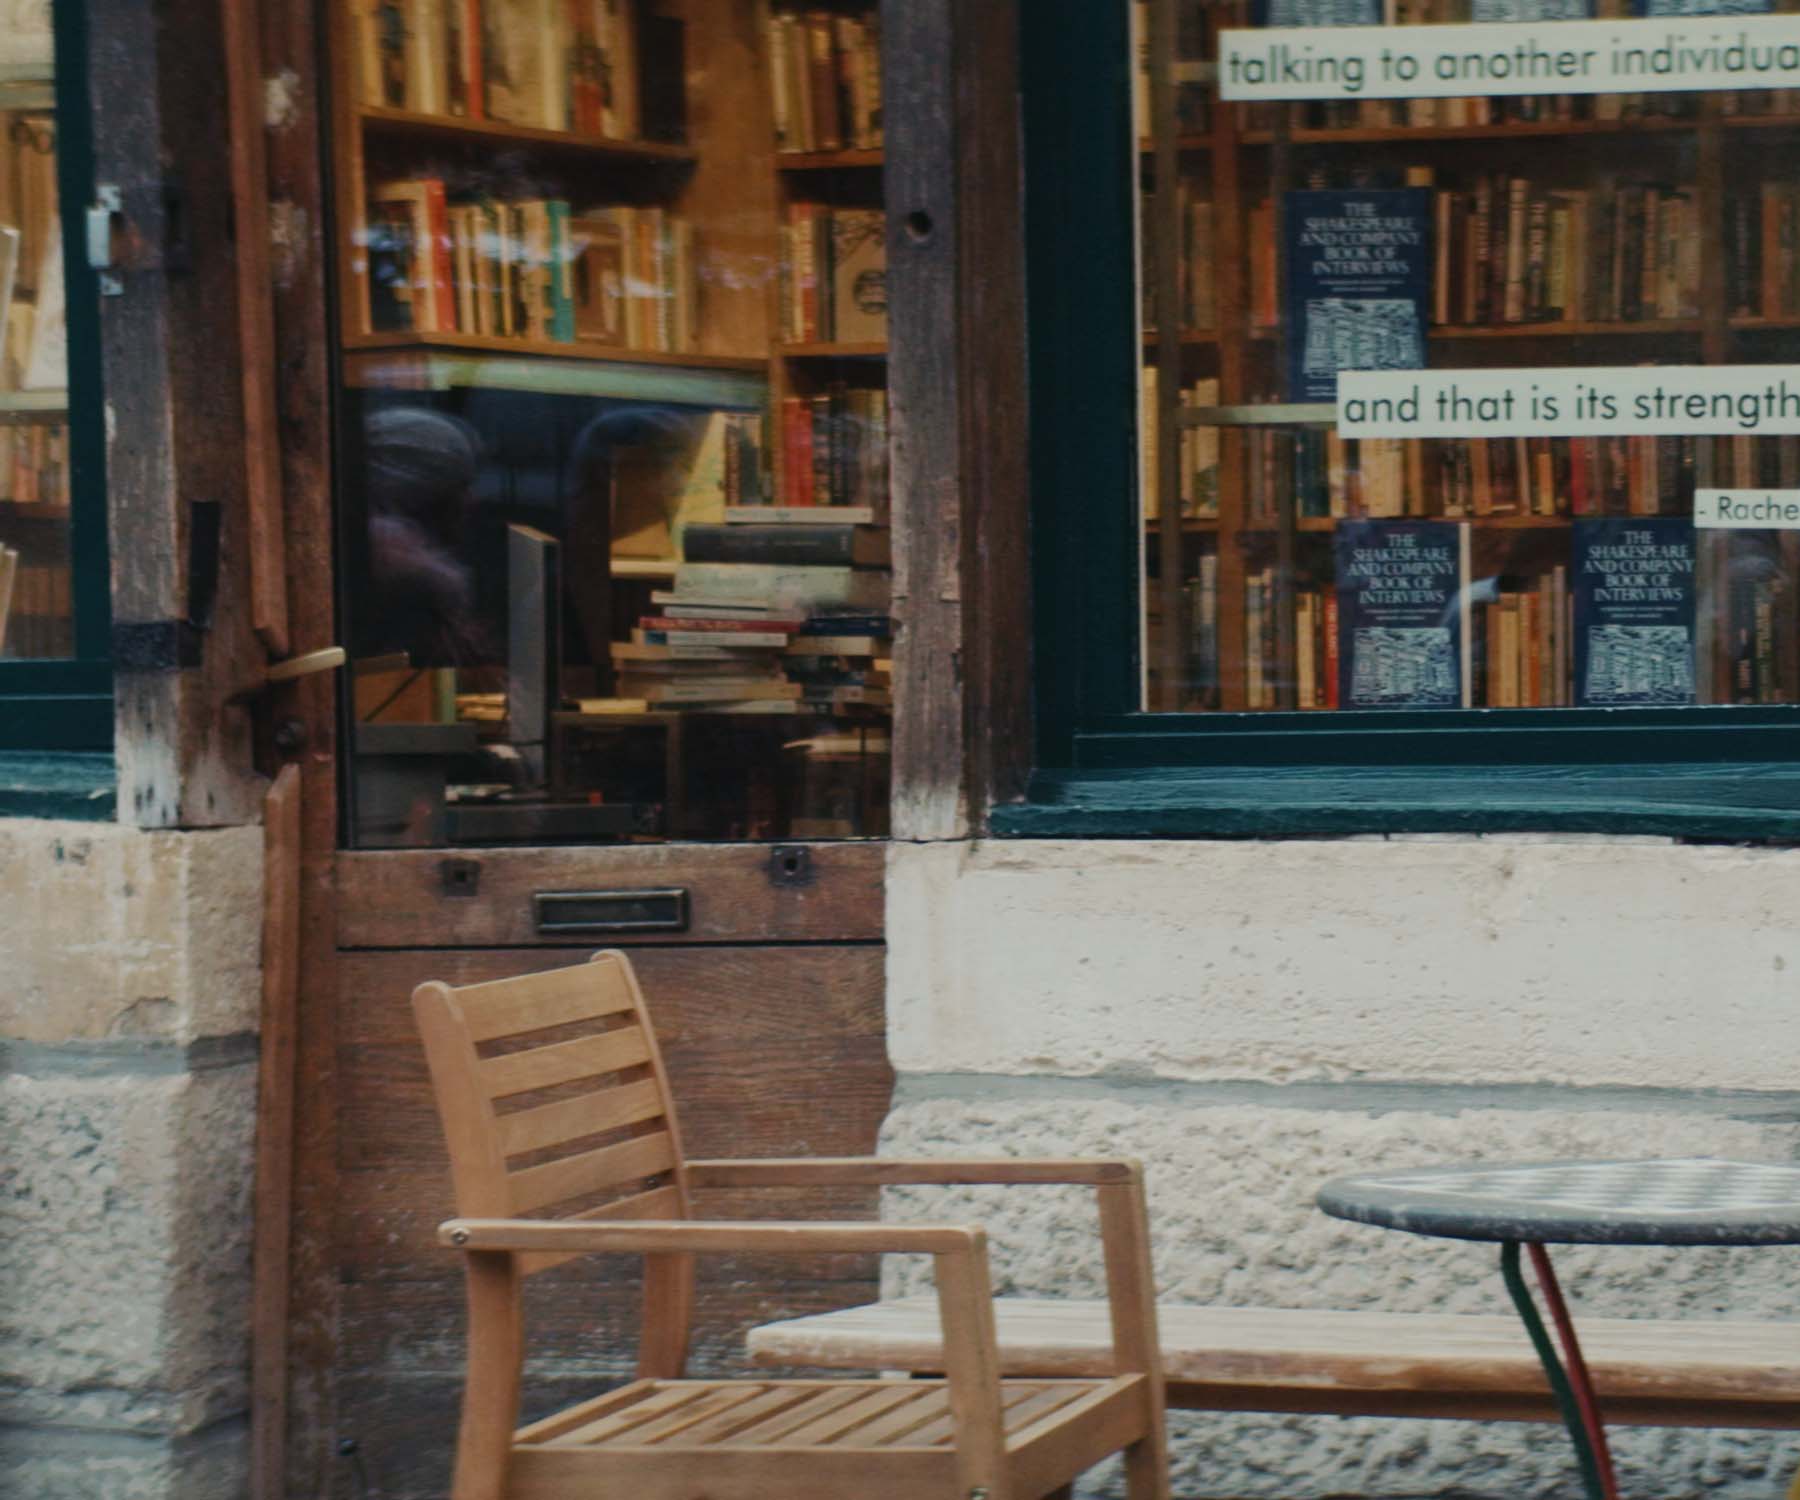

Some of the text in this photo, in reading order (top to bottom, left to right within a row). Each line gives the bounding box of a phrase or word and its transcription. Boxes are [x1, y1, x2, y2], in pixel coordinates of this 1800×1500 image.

[1229, 44, 1365, 92] talking
[1381, 48, 1420, 81] to
[1434, 38, 1597, 81] another
[1345, 384, 1419, 423] and
[1436, 384, 1516, 422] that
[1531, 384, 1560, 421] is
[1576, 383, 1618, 420] its
[1386, 533, 1416, 548] THE
[1624, 531, 1654, 545] THE
[1348, 562, 1456, 576] AND COMPANY
[1583, 559, 1696, 573] AND COMPANY
[1369, 576, 1434, 590] BOOK OF
[1605, 573, 1672, 587] BOOK OF
